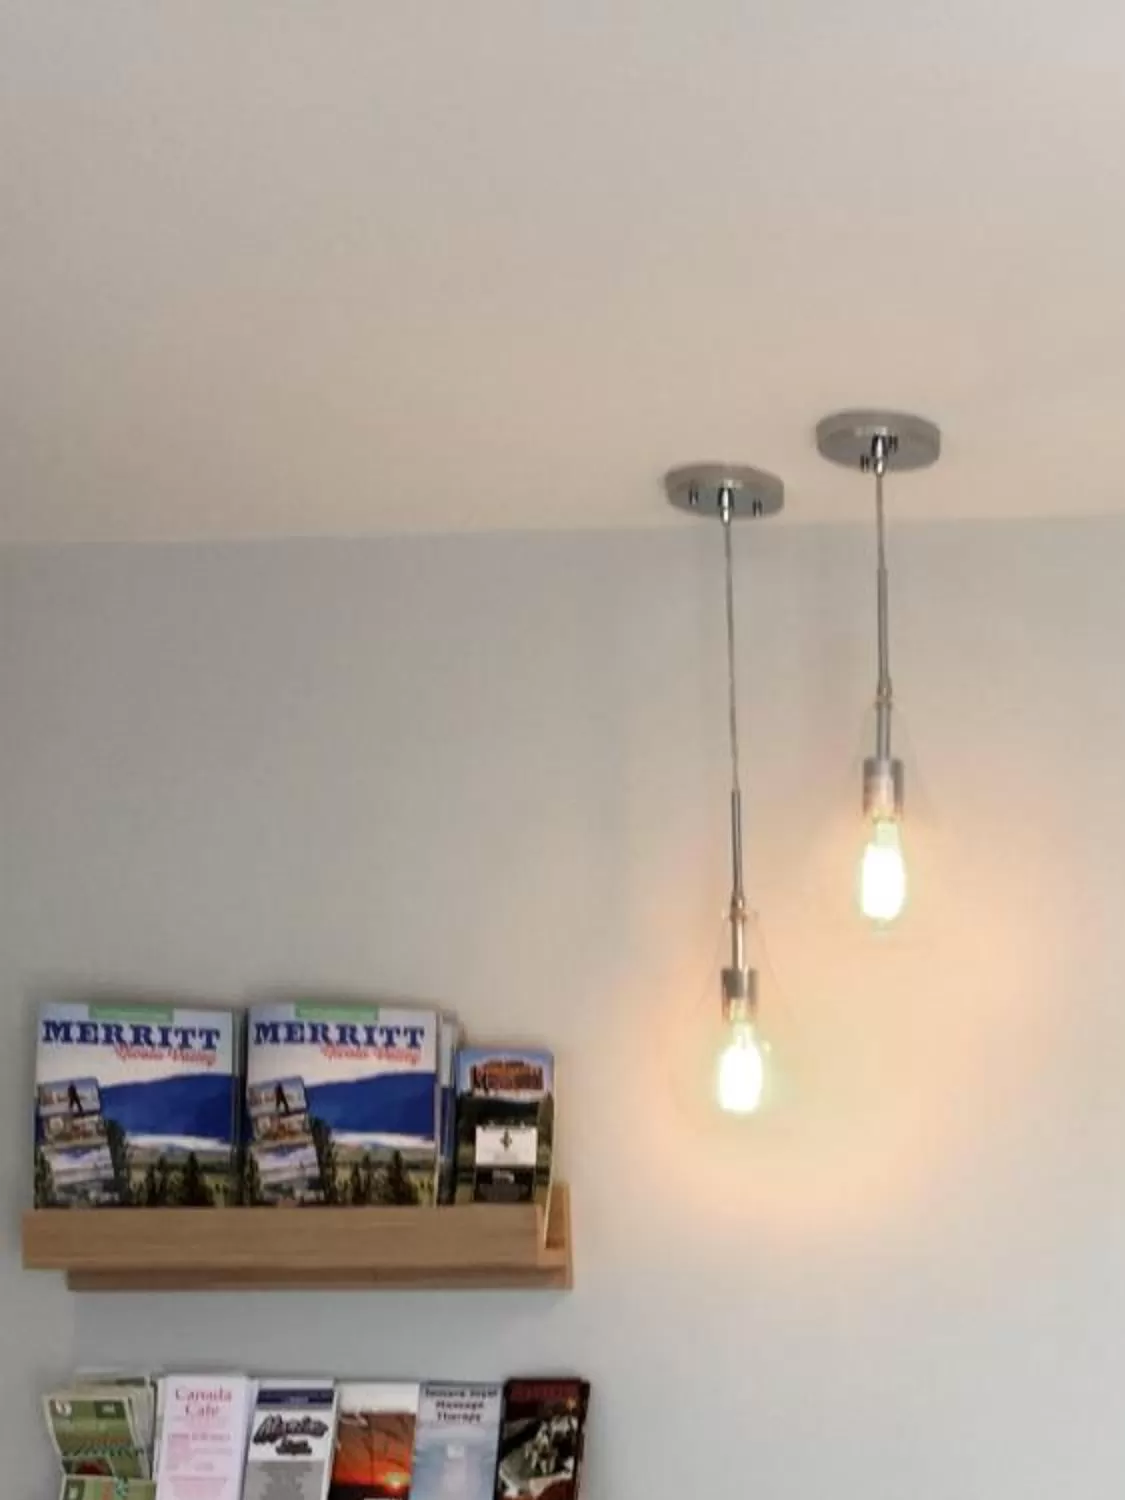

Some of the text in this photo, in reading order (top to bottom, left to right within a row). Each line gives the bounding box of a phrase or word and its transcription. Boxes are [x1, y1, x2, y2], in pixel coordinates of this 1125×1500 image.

[43, 1020, 220, 1051] MERRITT
[254, 1021, 425, 1050] MERRITT
[175, 1385, 233, 1401] Canada
